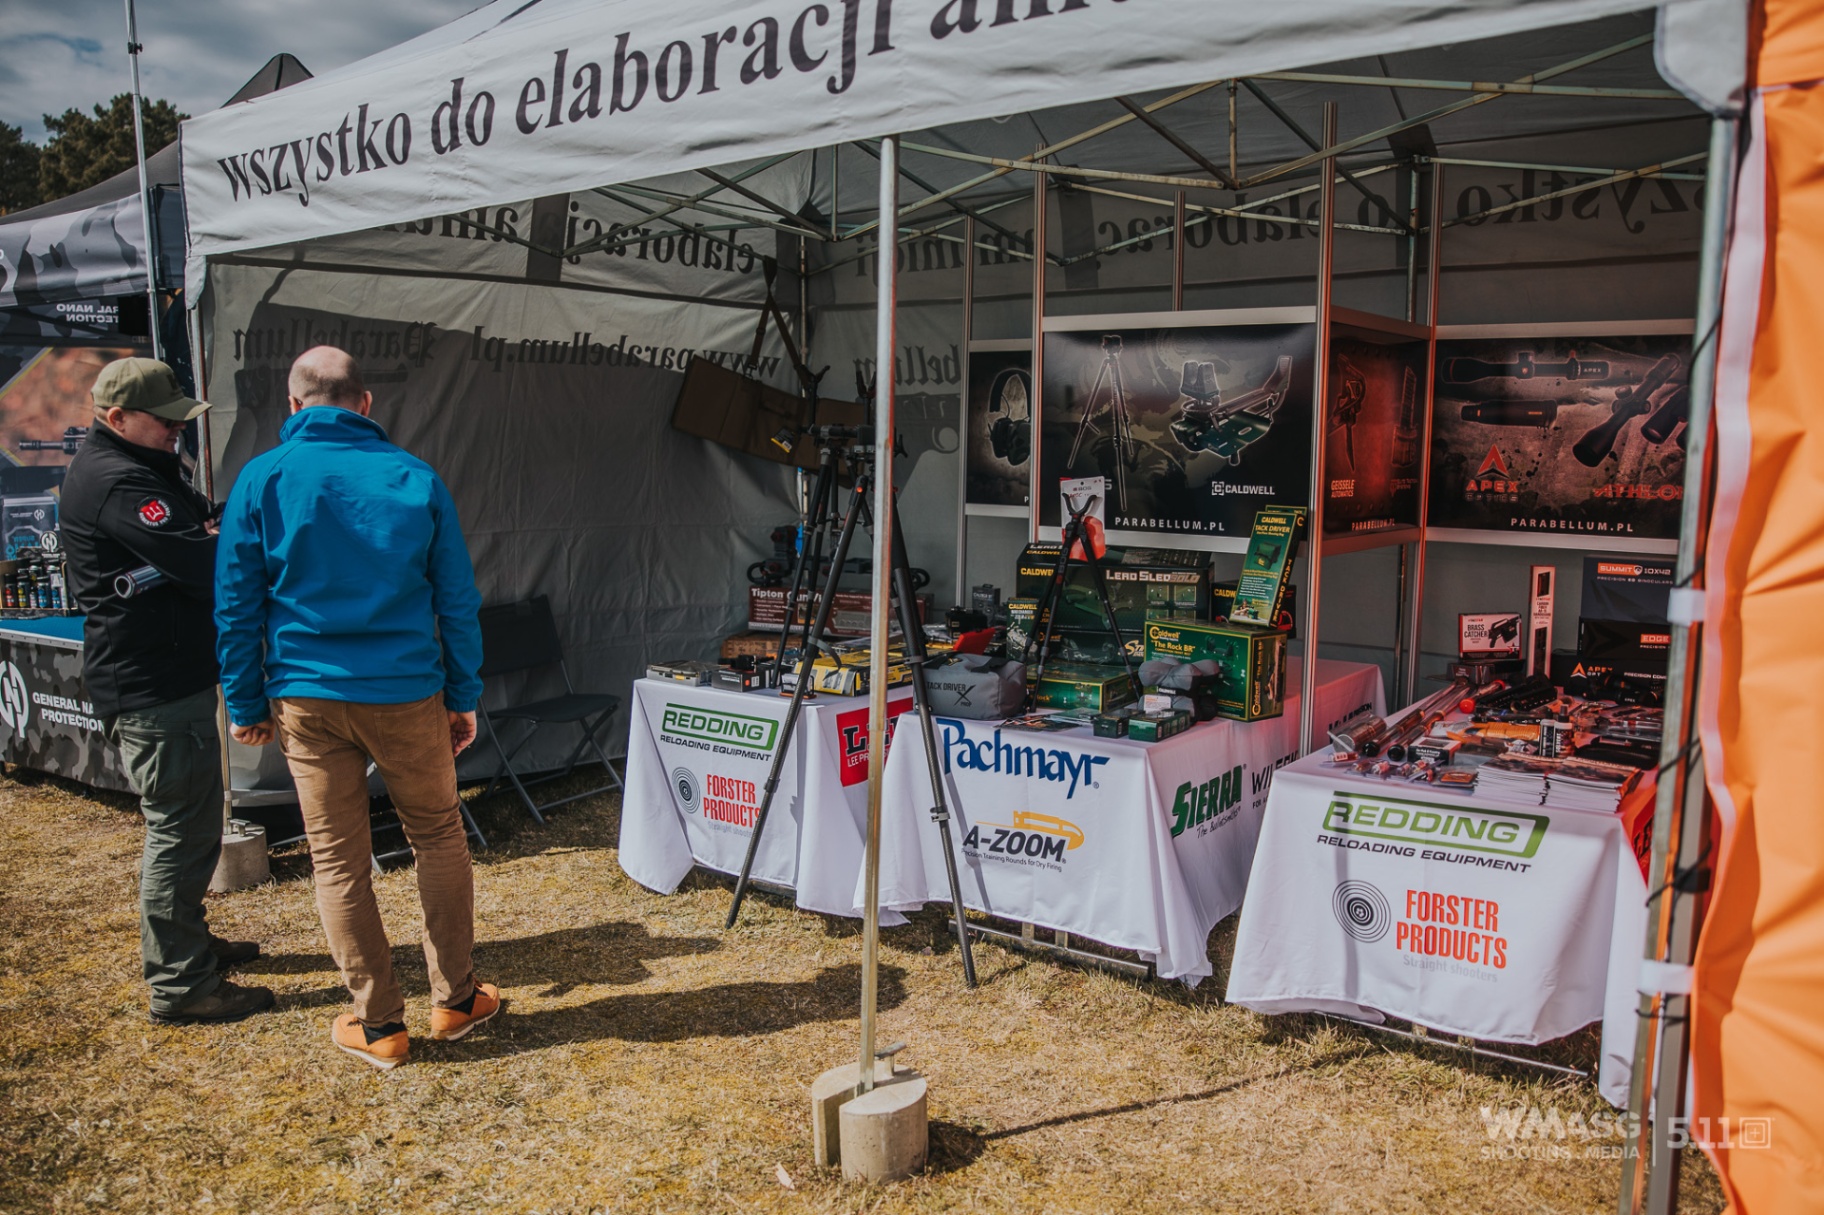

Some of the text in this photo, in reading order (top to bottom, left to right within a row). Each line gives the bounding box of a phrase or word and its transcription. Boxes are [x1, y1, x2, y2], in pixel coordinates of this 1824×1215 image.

[217, 0, 895, 207] wszystko do elaboracji
[1224, 483, 1276, 496] CALDWELL
[1330, 479, 1355, 491] GEISSELE
[1466, 479, 1519, 493] APEX
[1331, 489, 1354, 498] AUTOMATICS
[1114, 516, 1225, 532] PARABELLUM.PL
[1261, 516, 1287, 525] CALDWELL
[1351, 517, 1396, 531] PARABELLUM.PL
[1510, 517, 1634, 533] PARABELLUM.PL
[1020, 567, 1055, 577] CALDWE
[1281, 558, 1292, 584] TACK
[1599, 565, 1672, 576] SUMMIT 10X42
[751, 588, 784, 600] Tipton
[1271, 584, 1286, 622] DRIVER
[1149, 626, 1181, 640] Caldwell
[1463, 630, 1488, 638] CATCHER
[1467, 623, 1485, 631] BRASS
[1642, 635, 1669, 643] EDGE
[1167, 642, 1183, 653] Rock
[1623, 671, 1652, 679] PRECISION
[926, 681, 942, 690] TACK
[942, 682, 967, 692] DRIVER
[32, 691, 94, 714] GENERAL NA
[662, 709, 764, 741] REDDING
[659, 734, 772, 762] RELOADING EQUIPMENT
[847, 755, 859, 768] LEE
[936, 718, 1110, 800] Pachmayr
[706, 773, 756, 805] FORSTER
[1169, 764, 1243, 839] SIERRA
[1331, 800, 1521, 845] REDDING
[962, 824, 1067, 863] A-ZOOM
[1316, 834, 1533, 874] RELOADING EQUIPMENT
[983, 852, 1006, 864] Training
[1006, 855, 1027, 866] Rounds
[1027, 858, 1036, 867] for
[1036, 860, 1047, 870] Dry
[1046, 862, 1063, 873] Firing
[1405, 889, 1499, 932] FORSTER
[1396, 921, 1508, 970] PRODUCTS
[1403, 954, 1499, 983] Straight shooters
